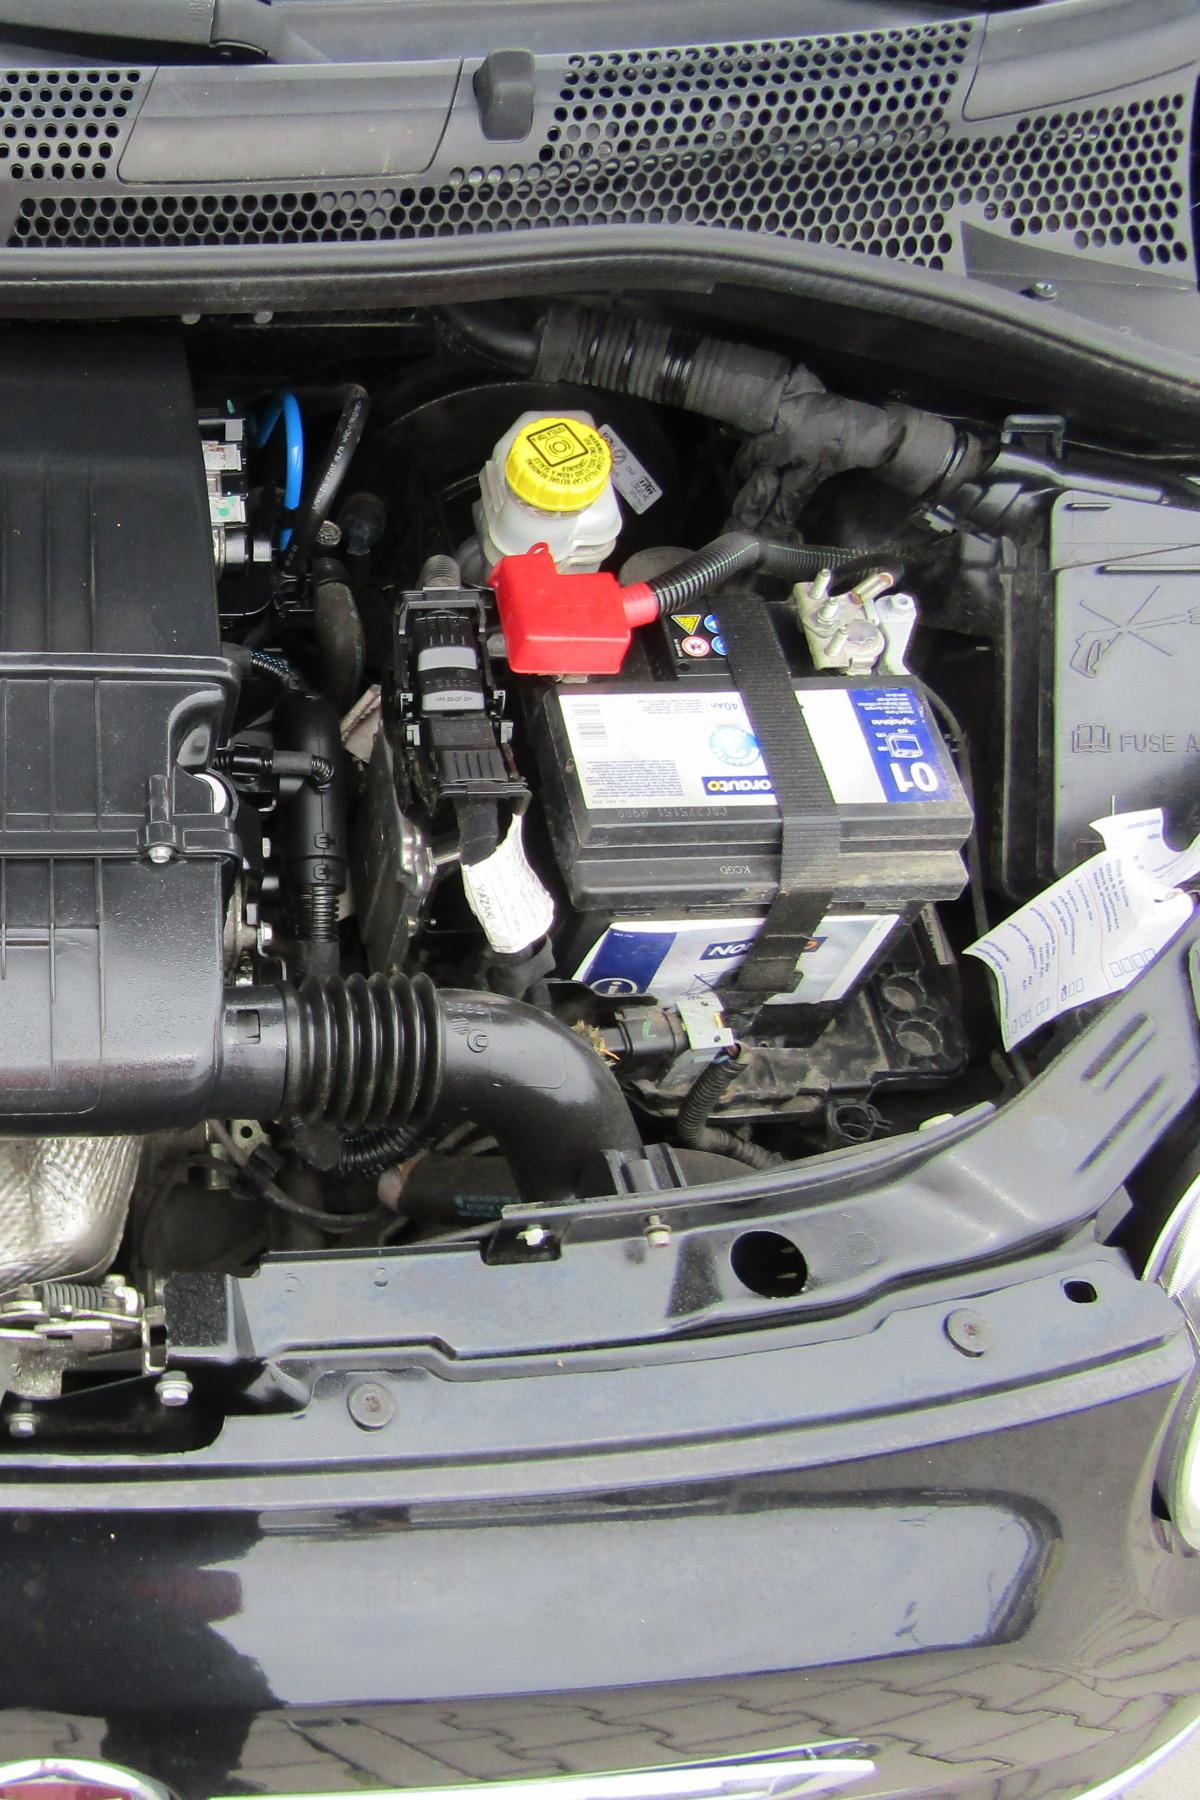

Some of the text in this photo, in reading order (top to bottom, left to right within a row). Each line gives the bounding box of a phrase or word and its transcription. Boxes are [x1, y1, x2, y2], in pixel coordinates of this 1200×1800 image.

[1120, 734, 1176, 753] FUSE
[707, 779, 772, 792] orauto
[890, 762, 938, 793] 01
[476, 884, 495, 920] YAZAKI
